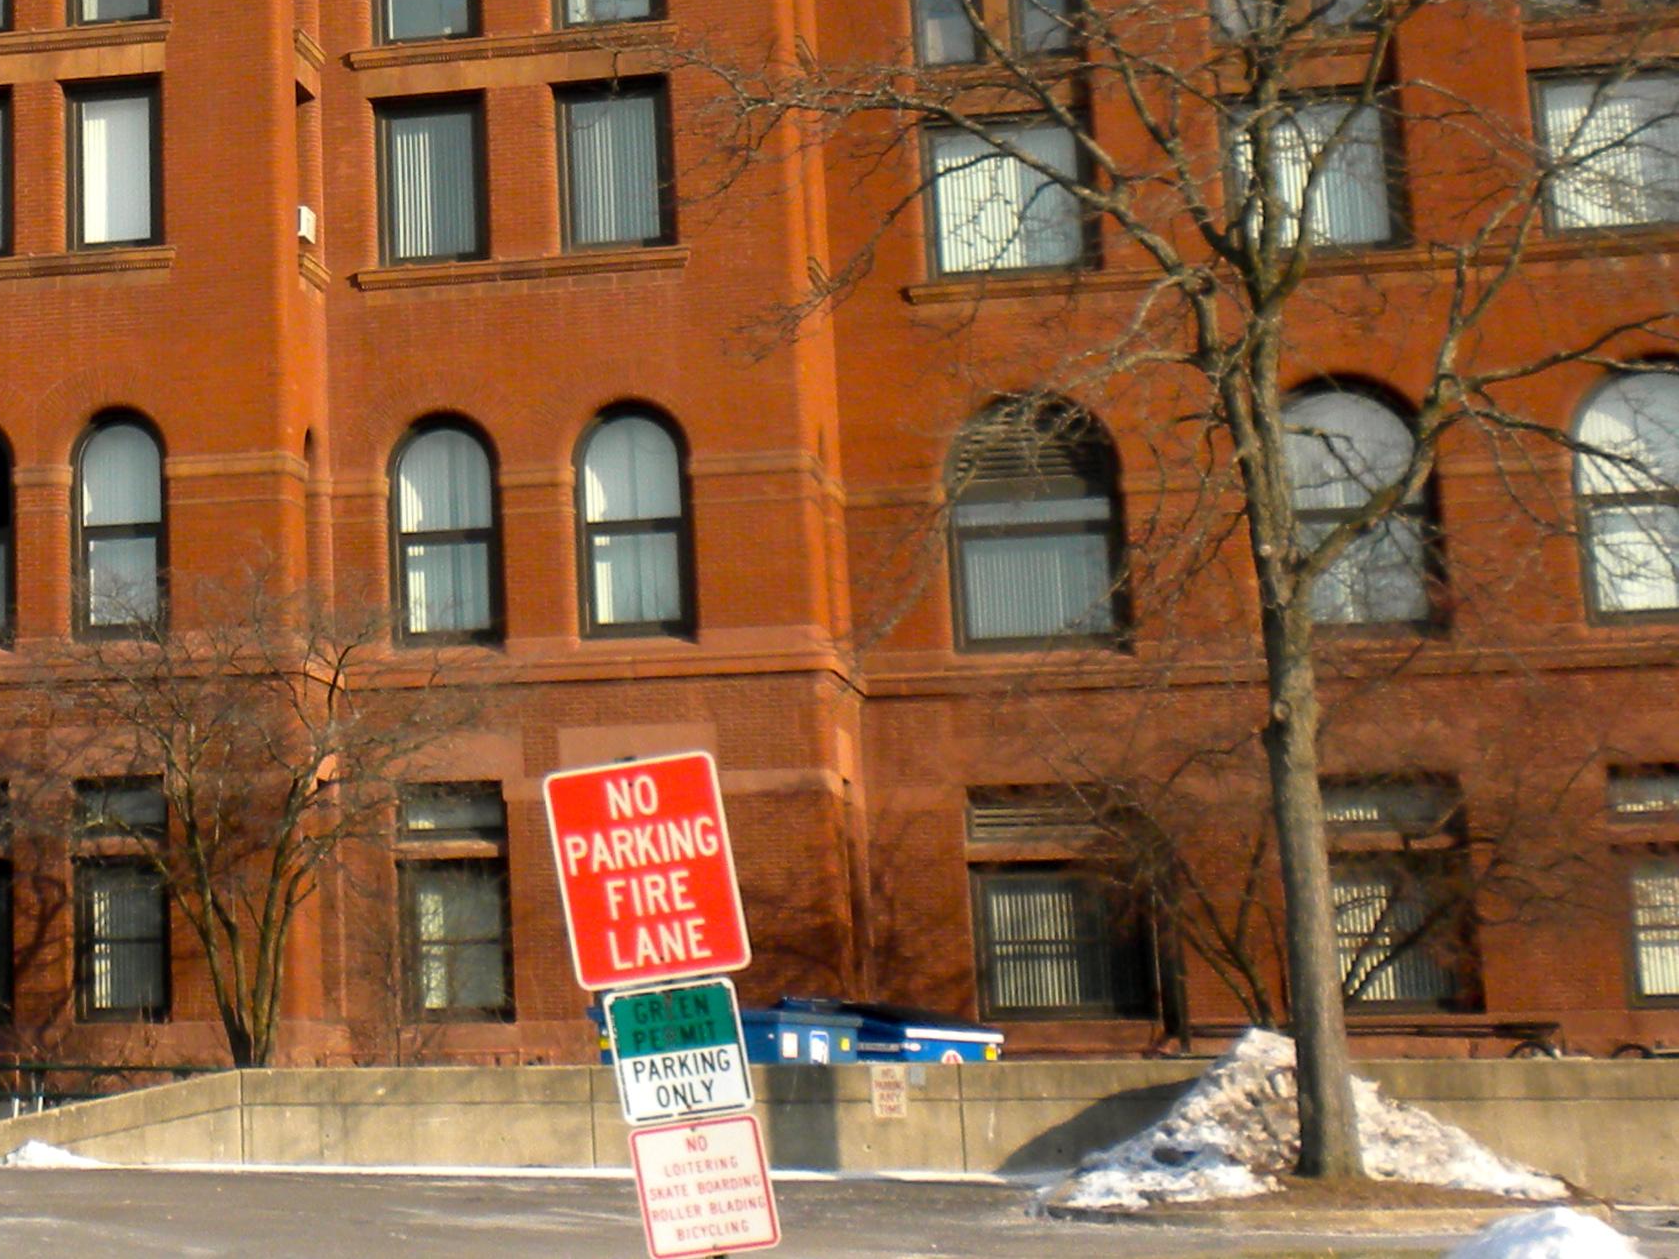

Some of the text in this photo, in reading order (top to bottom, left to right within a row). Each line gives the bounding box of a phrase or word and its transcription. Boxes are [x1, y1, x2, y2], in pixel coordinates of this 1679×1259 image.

[606, 774, 658, 820] NO
[564, 816, 719, 876] PARKING
[605, 870, 696, 921] FIRE
[608, 918, 712, 970] LANE
[633, 994, 710, 1025] GREN
[632, 1020, 716, 1052] PEMIT
[632, 1048, 731, 1083] PARKING
[656, 1078, 714, 1109] ONLY
[686, 1135, 708, 1153] NO
[664, 1156, 738, 1178] LOITERING
[649, 1174, 760, 1201] SKATE BOARDING
[652, 1196, 766, 1221] ROLLER BLADING
[676, 1220, 750, 1241] BICYCLING
